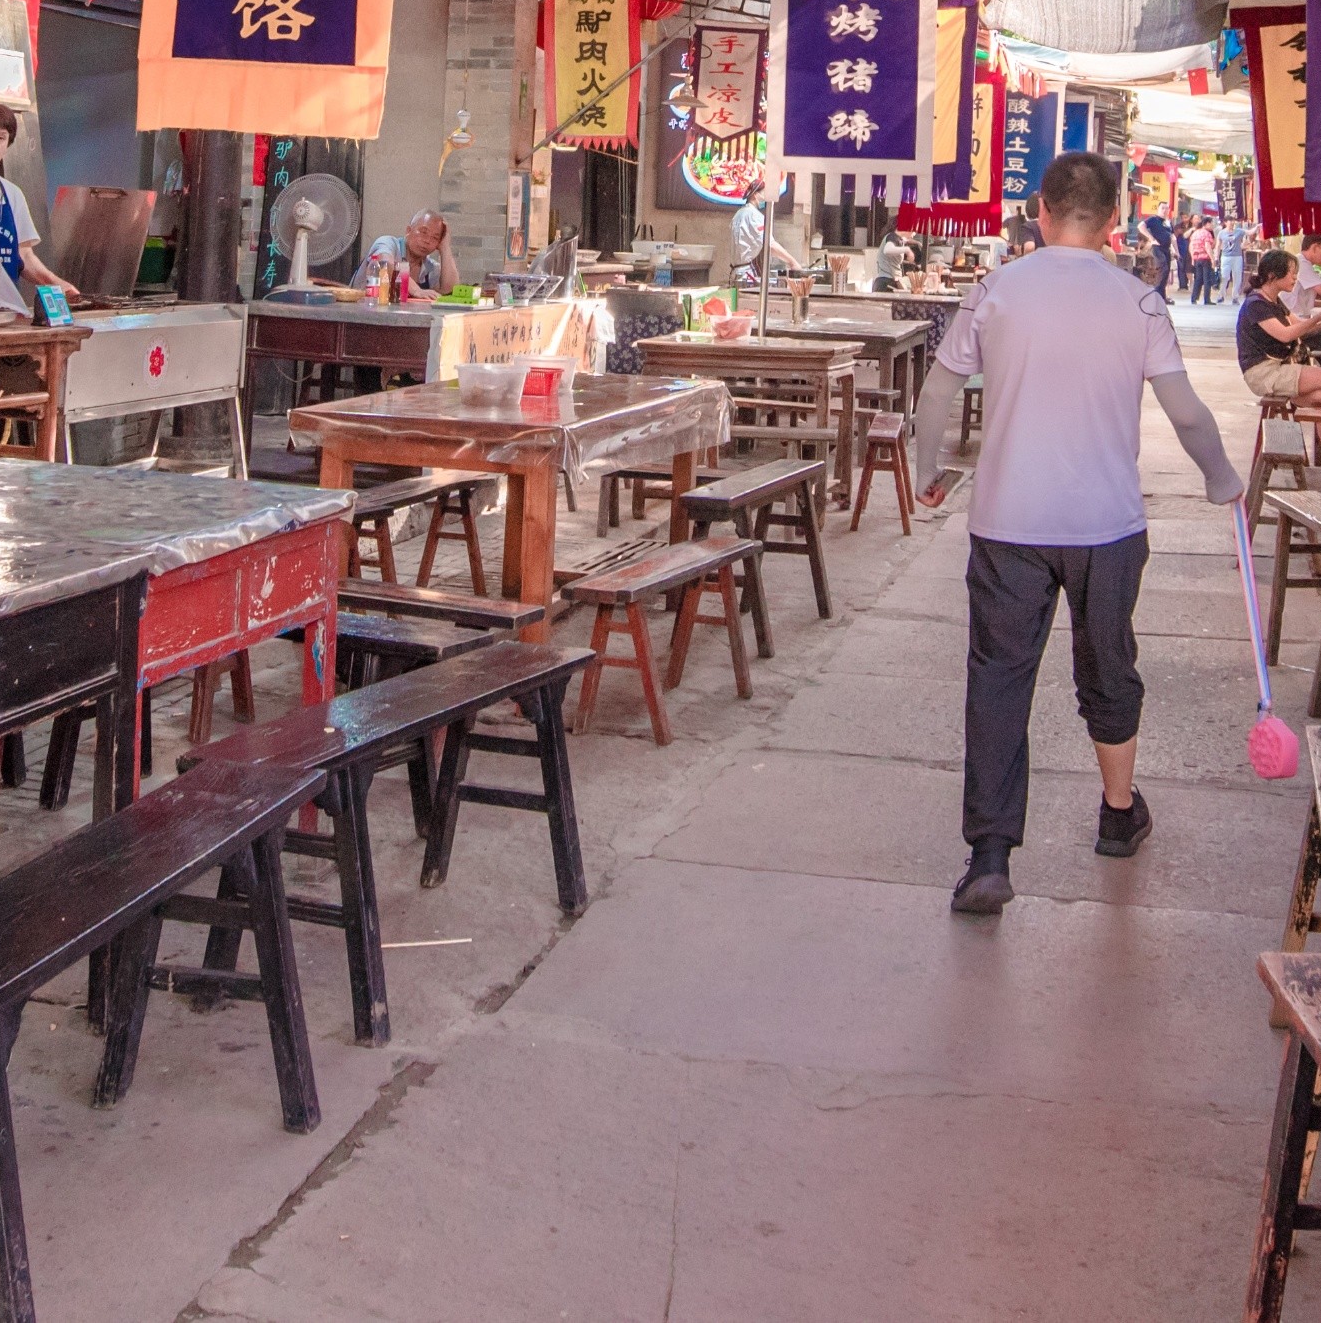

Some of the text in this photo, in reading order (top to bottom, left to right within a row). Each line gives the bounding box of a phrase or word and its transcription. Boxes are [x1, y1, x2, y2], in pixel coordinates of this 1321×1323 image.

[704, 35, 744, 128] 手工凉皮
[826, 3, 883, 151] 烤猪蹄
[1003, 97, 1033, 194] 酸辣土豆粉
